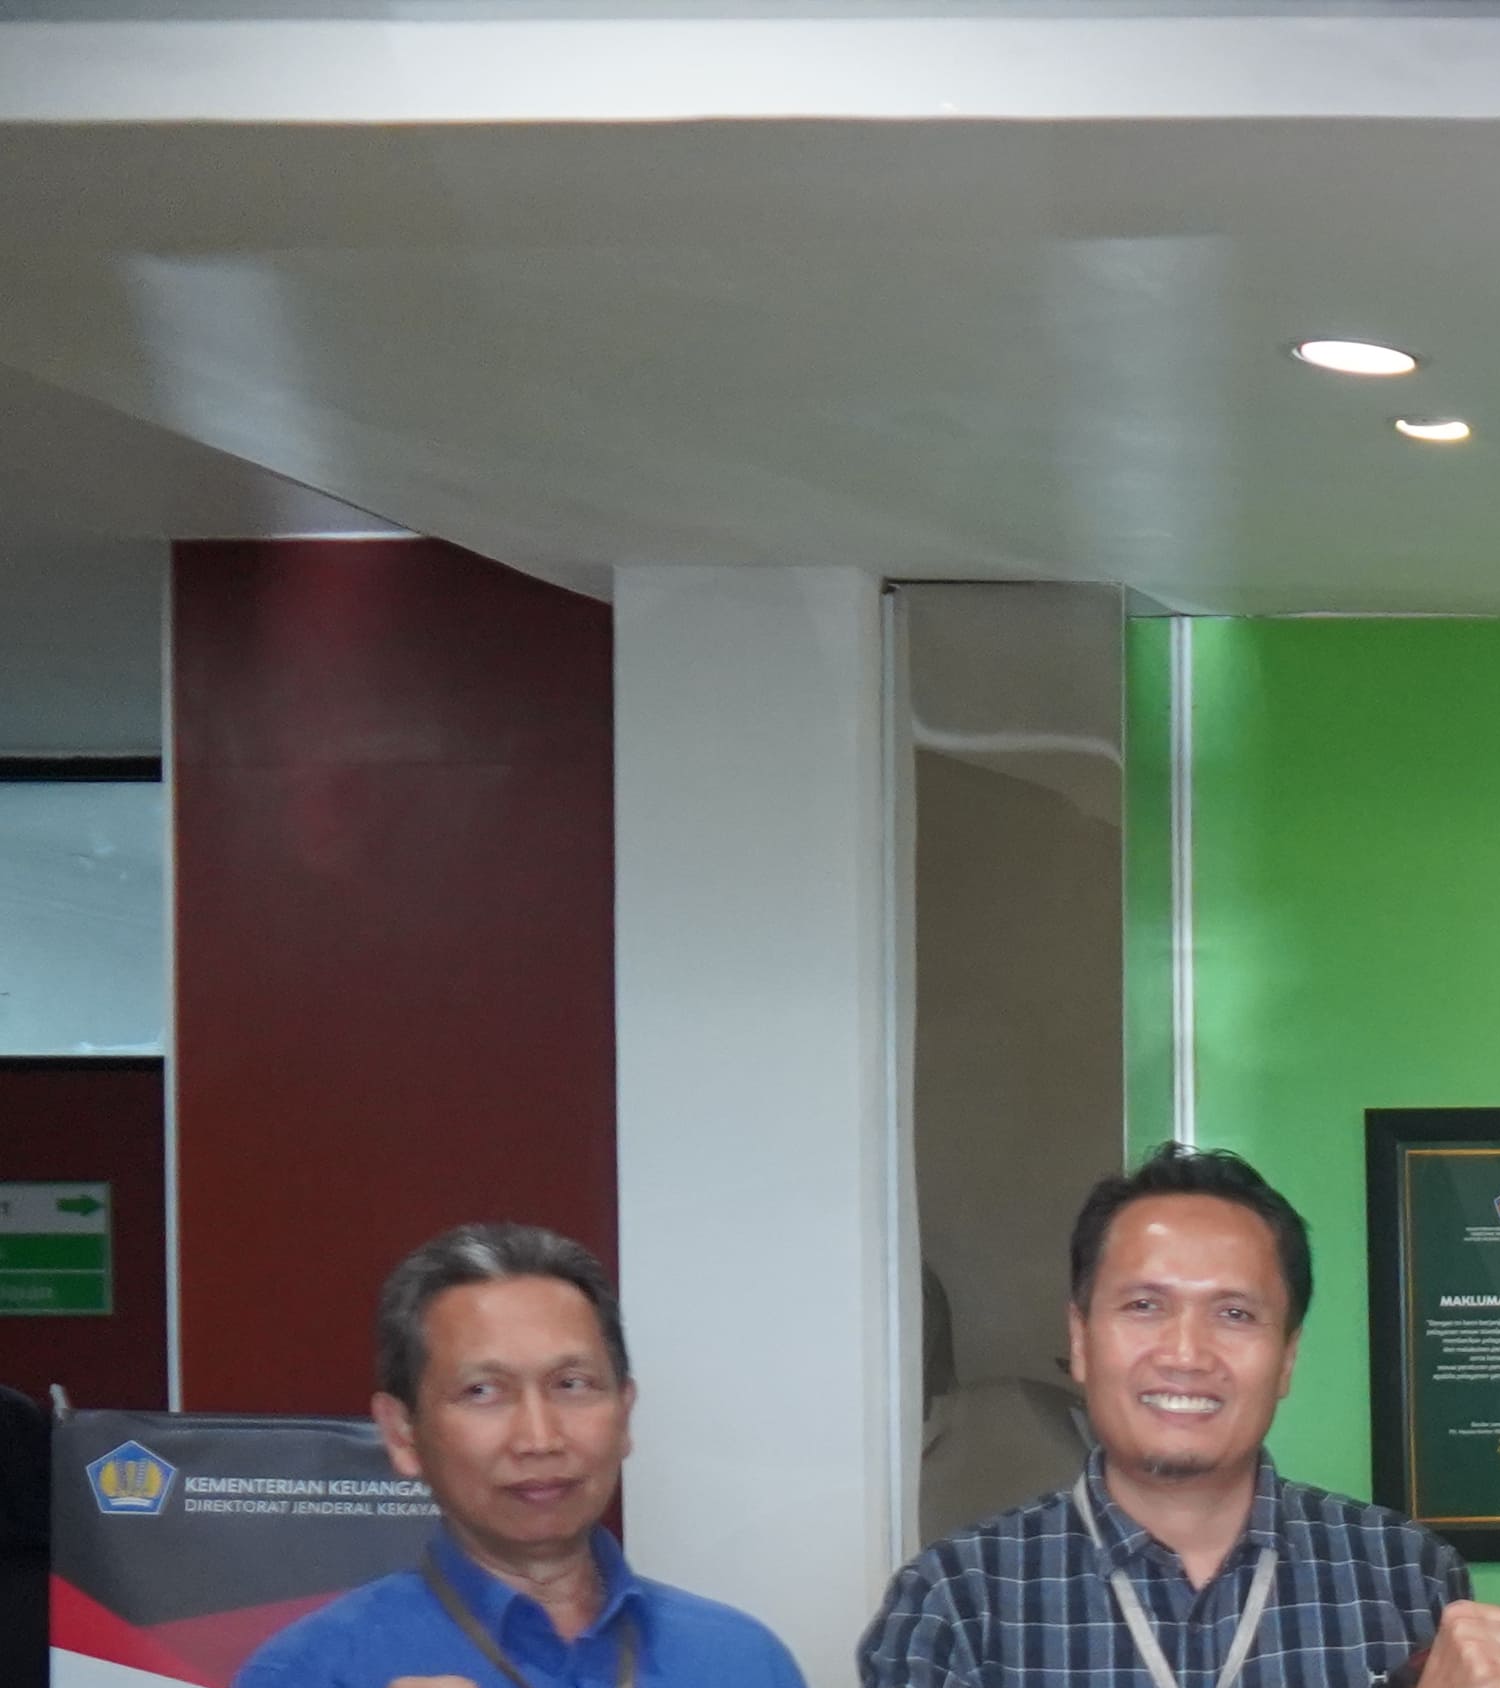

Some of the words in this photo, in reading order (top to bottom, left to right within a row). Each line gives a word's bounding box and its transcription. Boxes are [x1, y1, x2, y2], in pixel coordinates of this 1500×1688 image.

[184, 1477, 323, 1495] KEMENTERIAN
[184, 1499, 289, 1514] DIREKTORAT
[291, 1501, 373, 1516] JENDERAL
